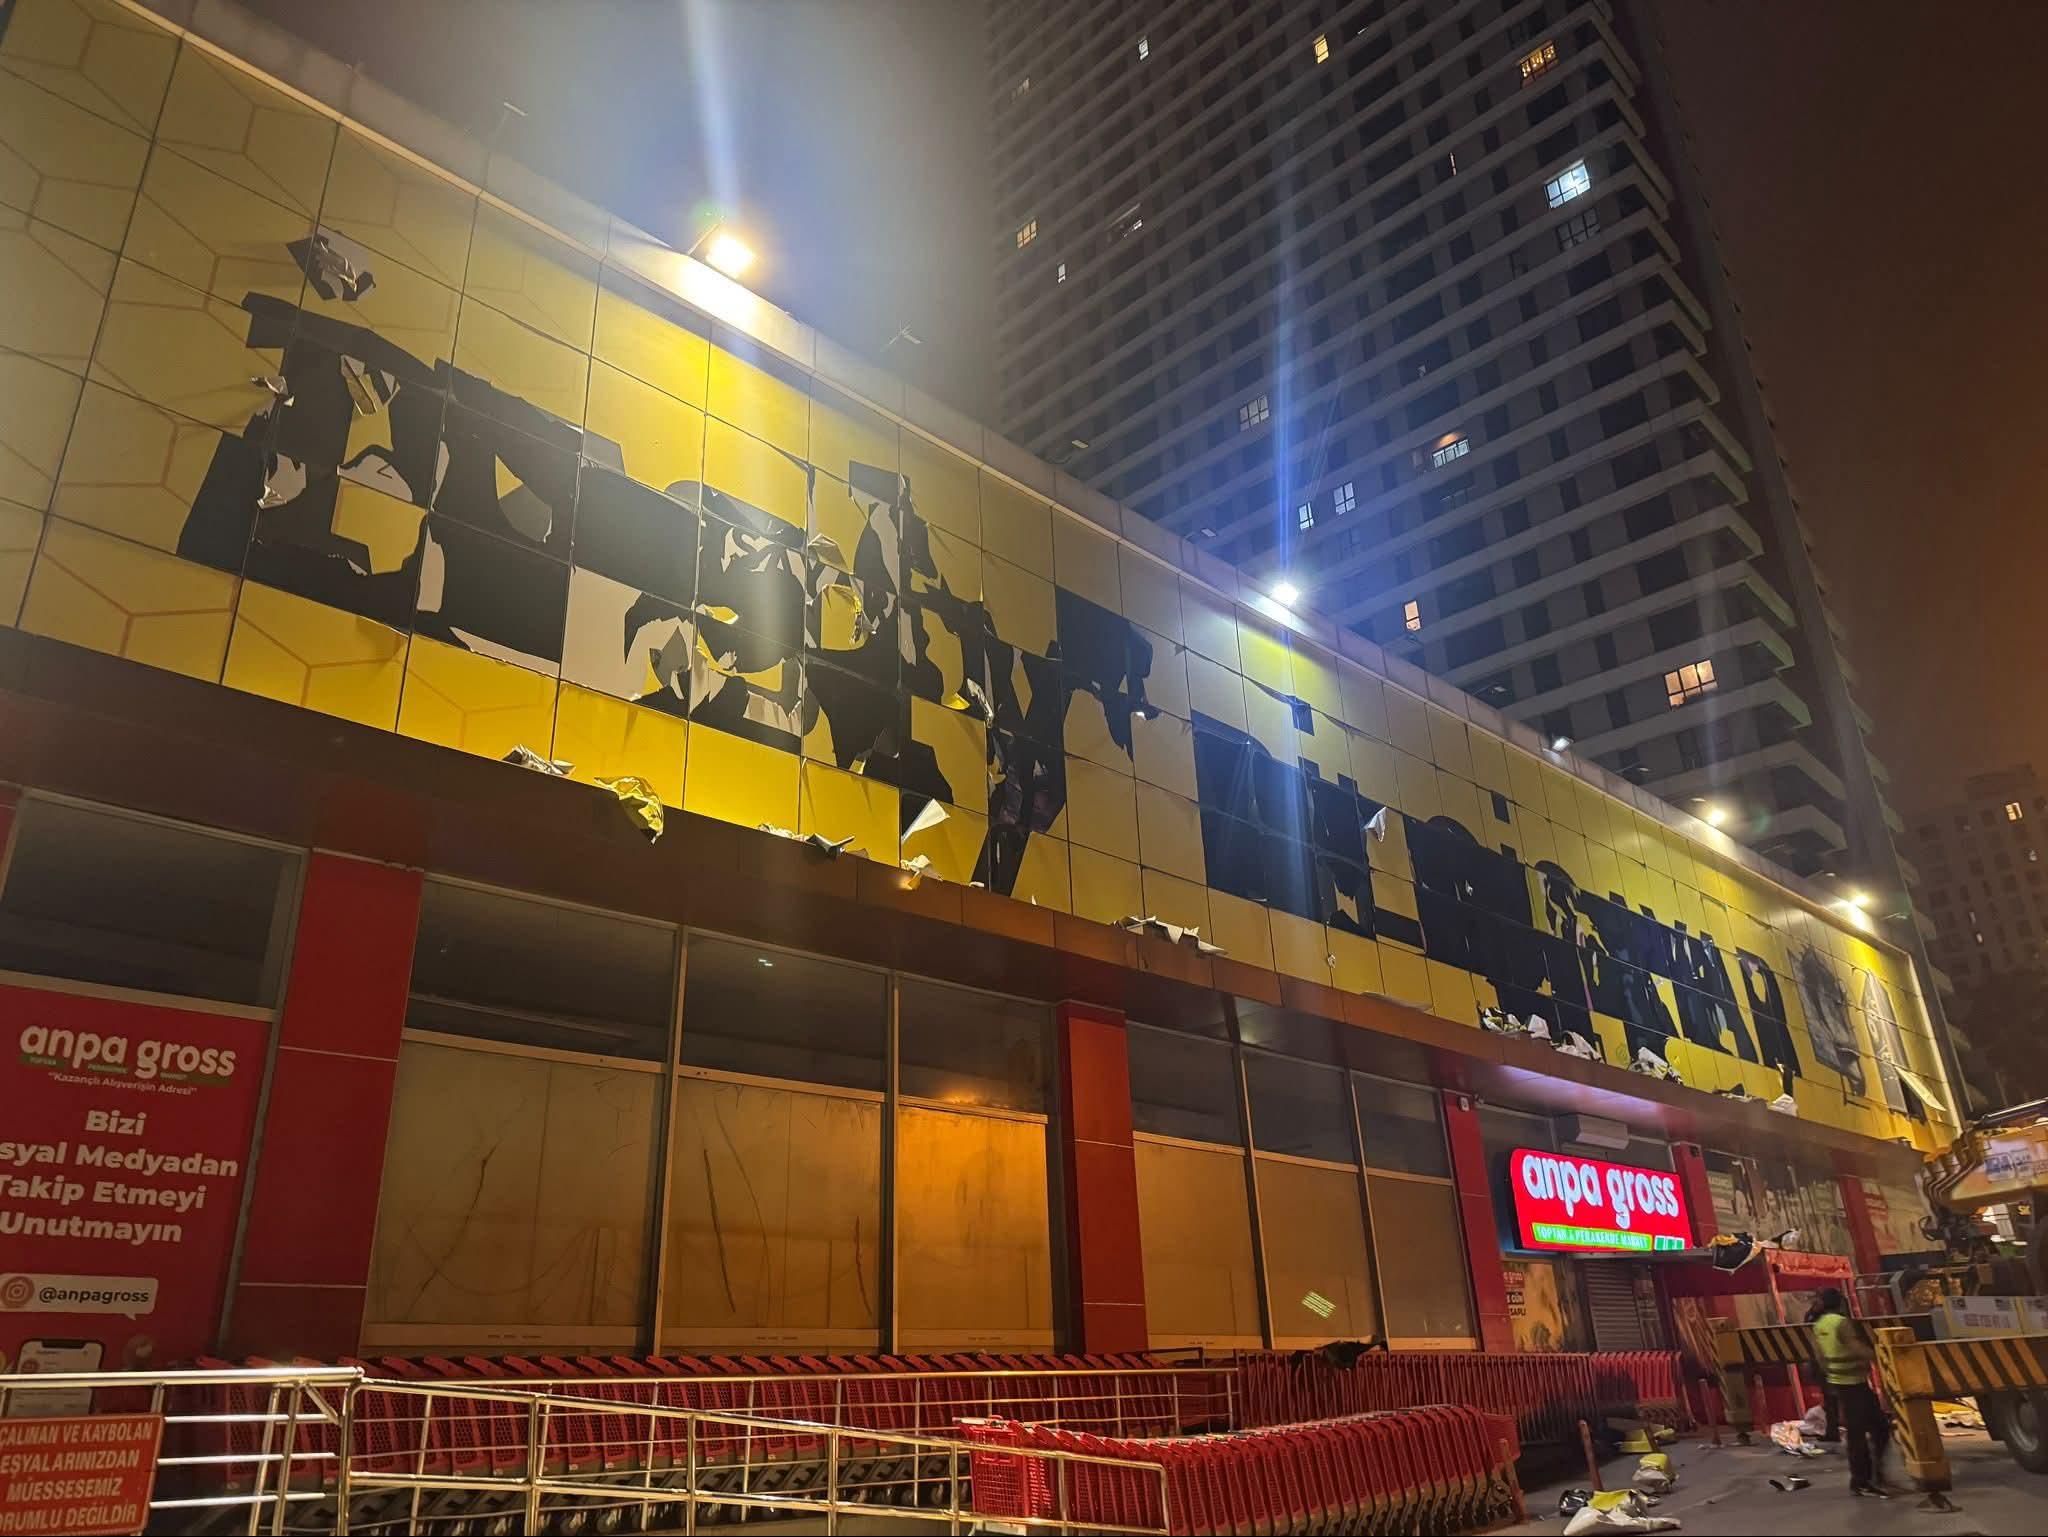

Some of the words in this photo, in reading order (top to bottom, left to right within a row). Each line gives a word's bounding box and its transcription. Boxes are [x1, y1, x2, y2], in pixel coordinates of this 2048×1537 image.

[20, 1025, 128, 1068] anpa
[135, 1040, 236, 1078] gross
[85, 1110, 147, 1136] Bizi
[75, 1144, 238, 1177] Medyadan
[0, 1175, 84, 1206] Takip
[92, 1181, 207, 1213] Etmeyi
[1522, 1154, 1603, 1217] anpa
[1605, 1168, 1679, 1229] gross
[0, 1211, 182, 1246] Unutmayın
[39, 1287, 149, 1304] @anpagross
[63, 1424, 79, 1443] VE
[80, 1422, 152, 1443] KAYBOLAN
[7, 1478, 123, 1501] MÜESSESEMİZ
[66, 1500, 136, 1527] DEĞİLDİR
